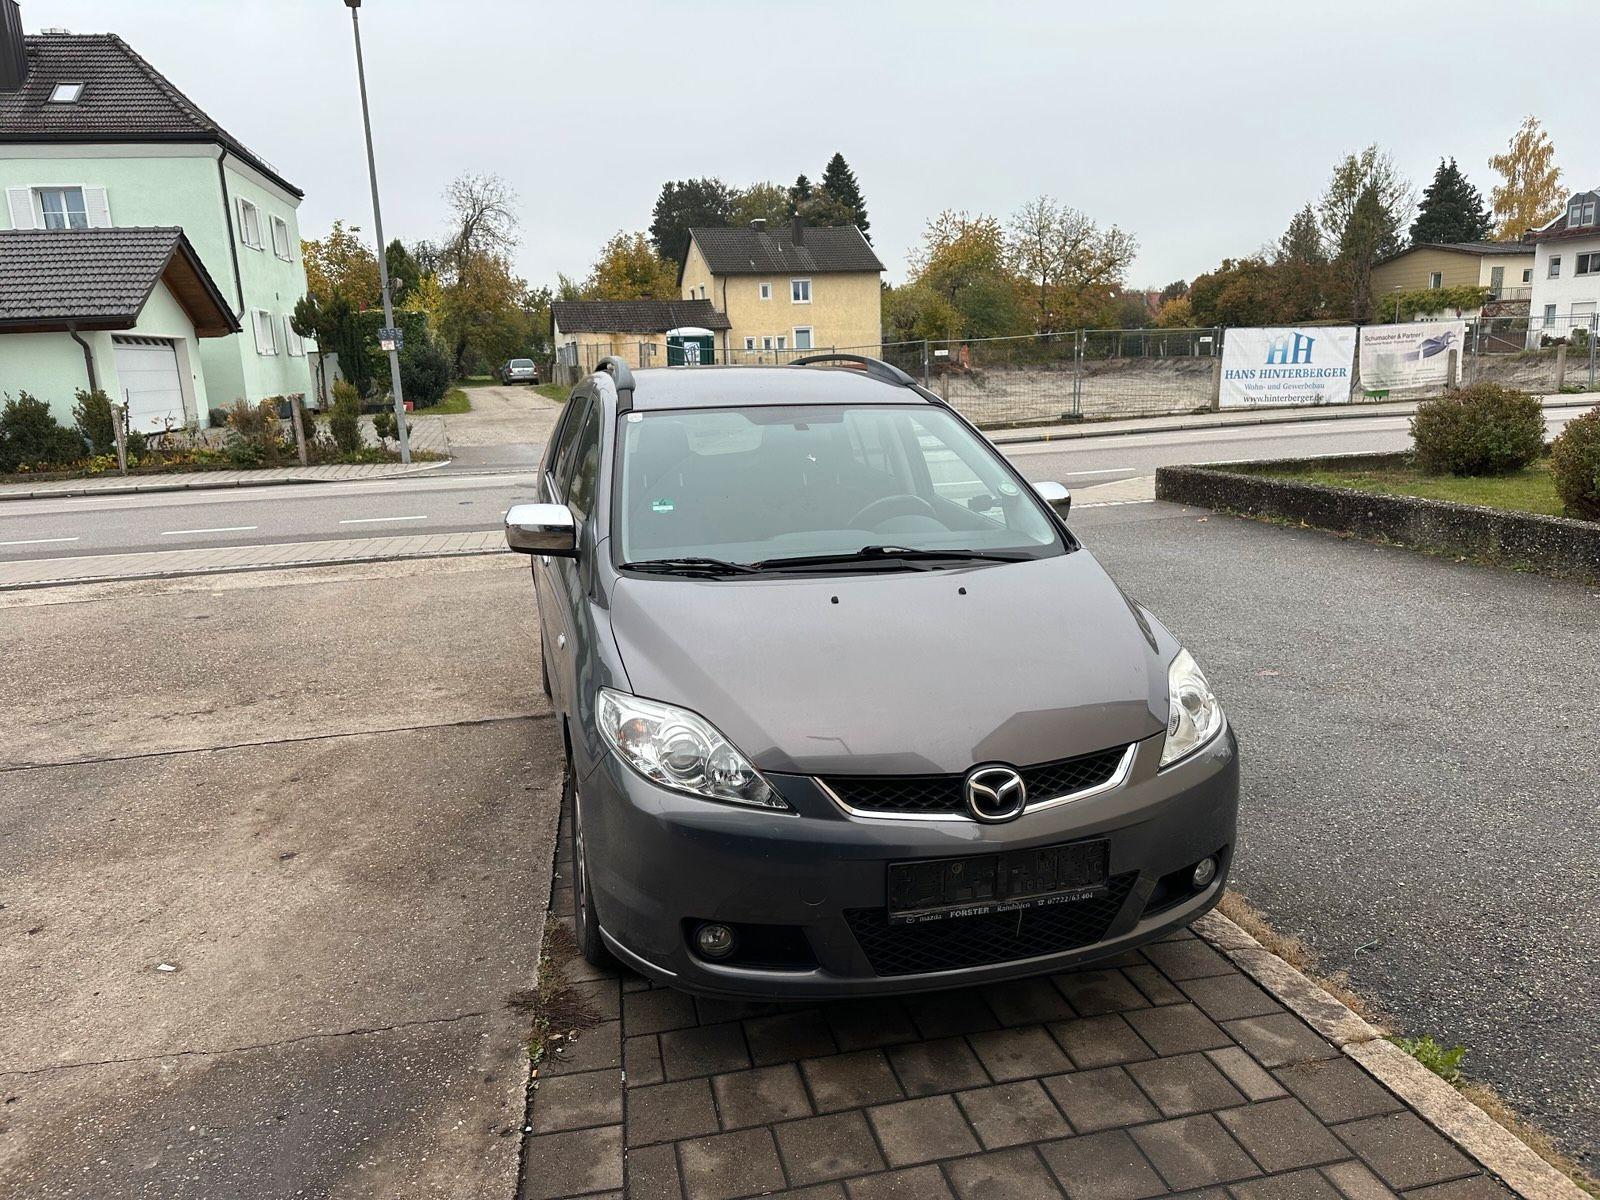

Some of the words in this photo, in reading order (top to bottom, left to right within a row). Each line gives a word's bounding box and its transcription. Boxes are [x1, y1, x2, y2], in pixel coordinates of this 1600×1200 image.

[1364, 334, 1397, 342] Schumacher
[1225, 369, 1256, 379] HANS
[1259, 367, 1347, 379] HINTERBERGER
[1244, 383, 1266, 391] Wohn-
[1283, 382, 1325, 390] Gewerbebau
[1243, 393, 1325, 404] www.hinterberger.de
[919, 914, 942, 922] mazda
[950, 907, 990, 918] FORSTER
